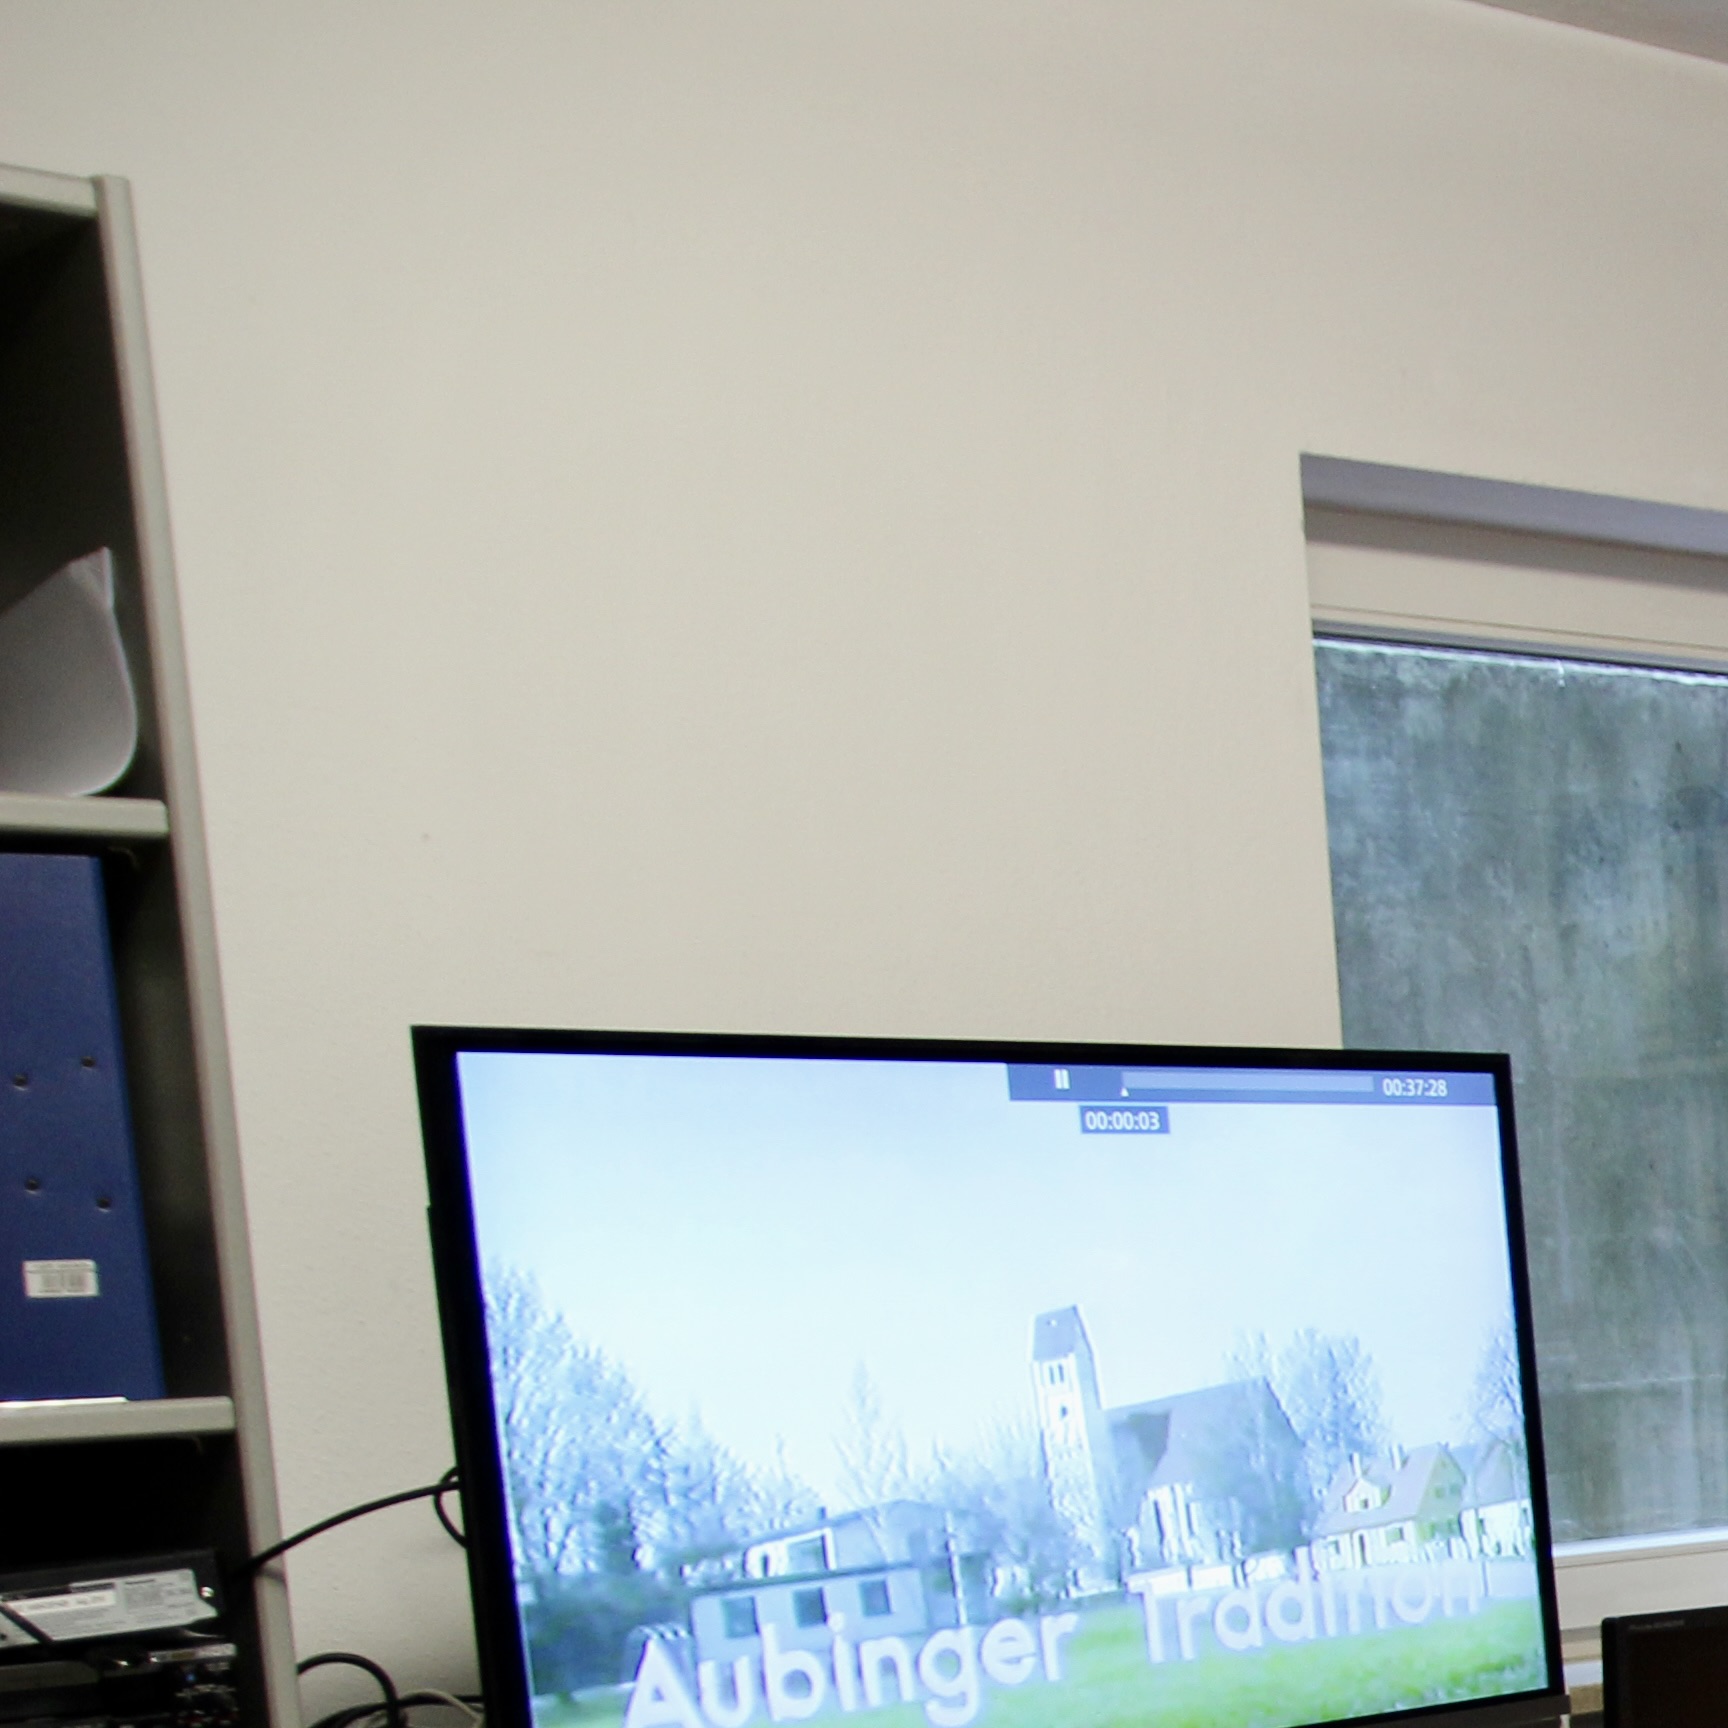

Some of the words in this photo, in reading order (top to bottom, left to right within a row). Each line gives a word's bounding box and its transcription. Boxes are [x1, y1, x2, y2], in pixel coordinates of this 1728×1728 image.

[1381, 1077, 1449, 1098] 00:37:28
[1084, 1110, 1162, 1132] 00:00:03
[1127, 1545, 1484, 1665] Tradition
